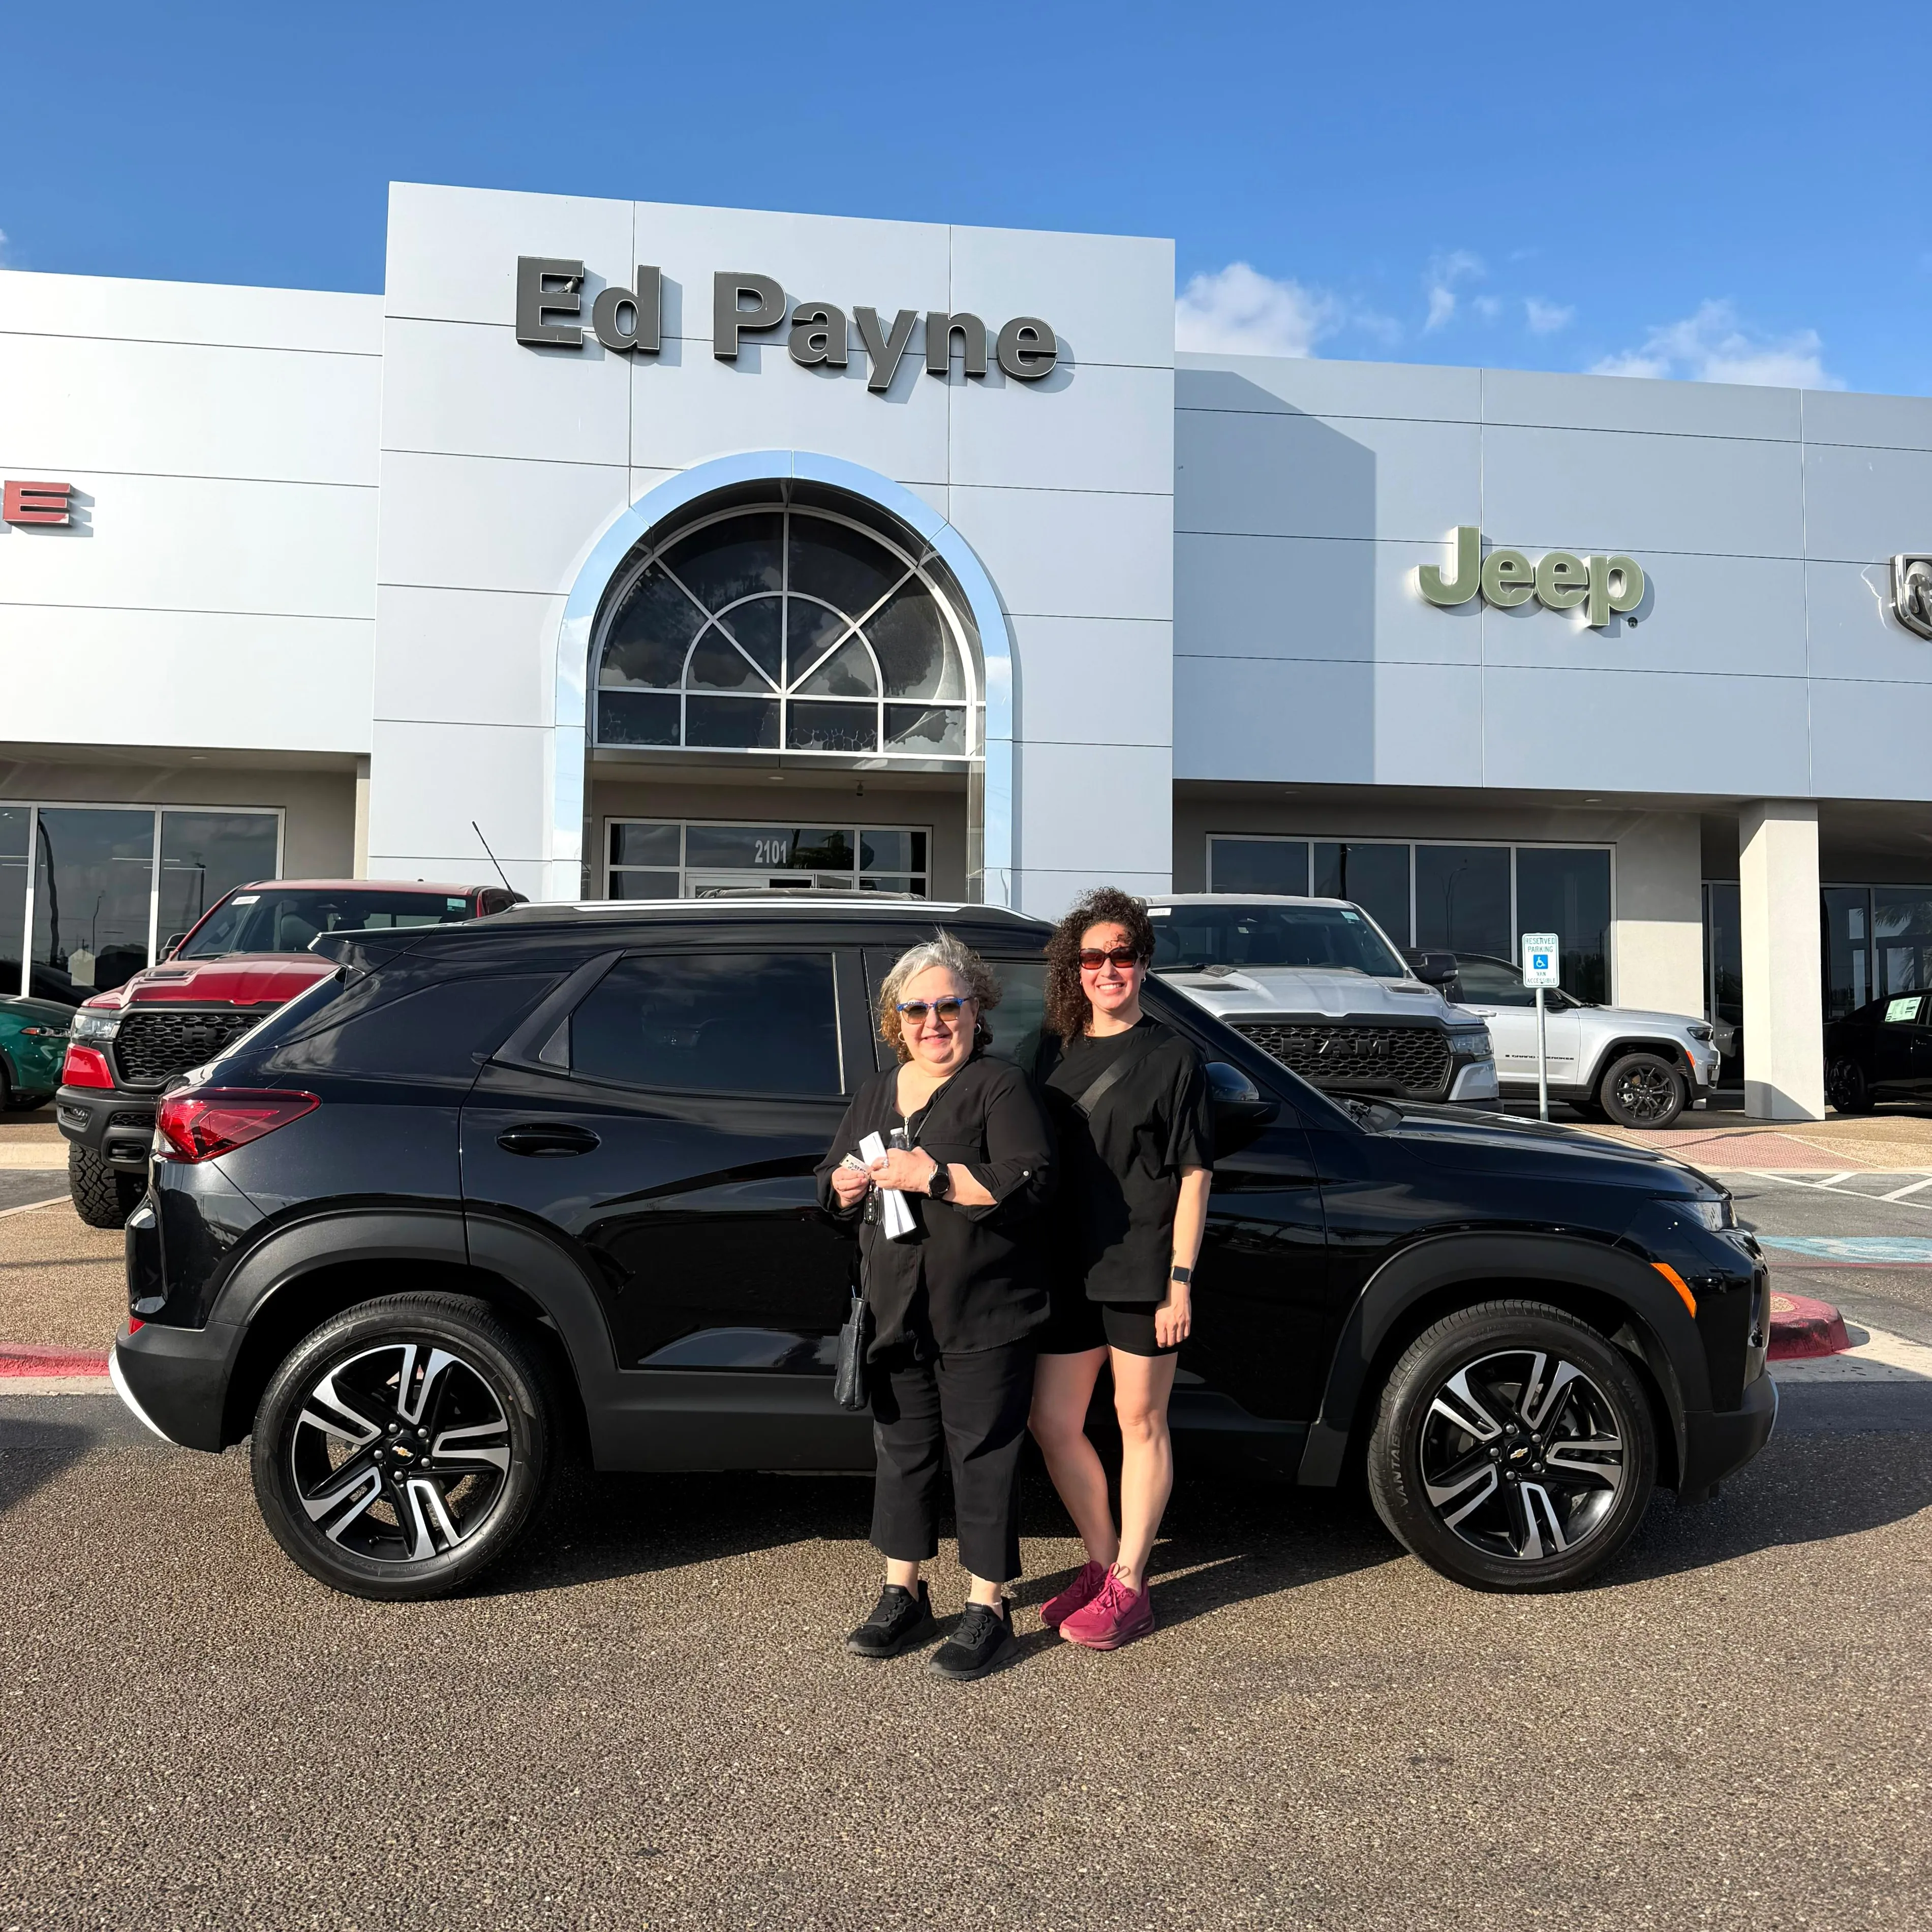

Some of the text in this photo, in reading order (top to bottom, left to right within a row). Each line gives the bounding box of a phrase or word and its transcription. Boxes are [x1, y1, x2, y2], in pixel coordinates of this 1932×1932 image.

[516, 255, 1059, 392] Ed Payne
[1415, 525, 1644, 628] Jeep
[754, 840, 787, 864] 2101
[1281, 1038, 1390, 1055] RAM
